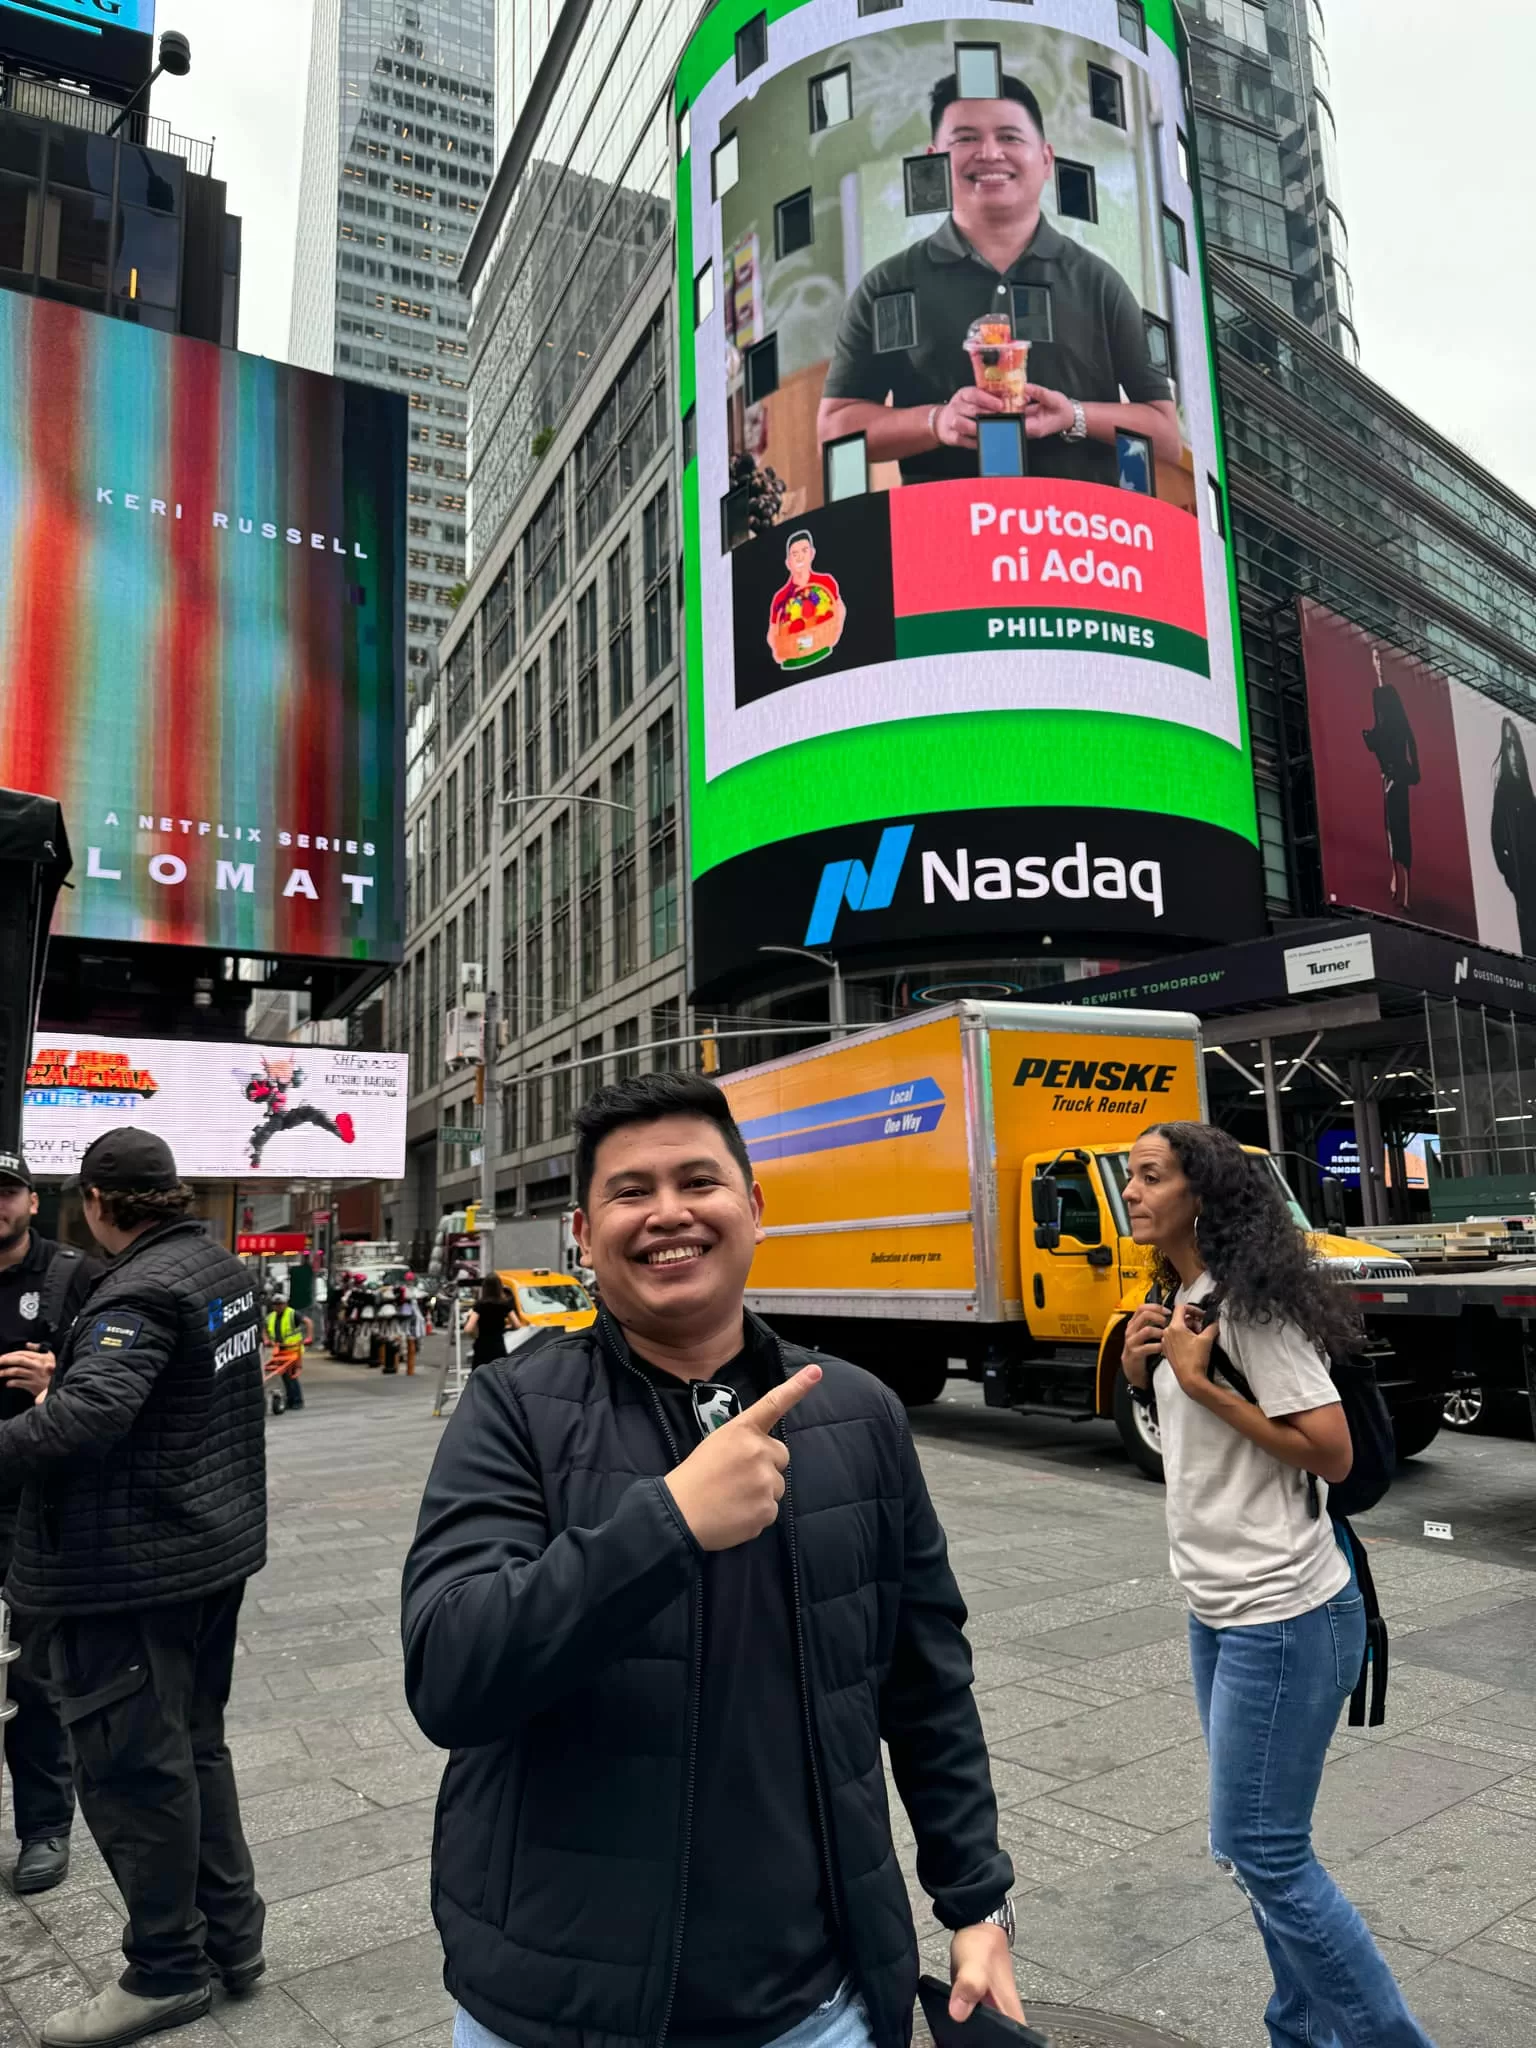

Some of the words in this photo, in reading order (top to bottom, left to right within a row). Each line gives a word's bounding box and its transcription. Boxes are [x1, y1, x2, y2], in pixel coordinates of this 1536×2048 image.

[96, 487, 183, 519] KERI
[212, 511, 368, 559] RUSSELL
[970, 502, 1154, 551] Prutasan
[992, 546, 1029, 582] ni
[1040, 549, 1143, 593] Adan
[988, 617, 1155, 649] PHILIPPINES
[104, 811, 120, 826] A
[138, 815, 262, 842] NETFLIX
[278, 831, 376, 857] SERIES
[86, 846, 375, 905] LOMAT
[922, 842, 1164, 917] Nasdaq
[1306, 960, 1351, 976] Turner
[1473, 968, 1504, 984] QUESTION
[1505, 977, 1524, 989] TODAY
[1082, 987, 1138, 1006] REWRITE
[1012, 1058, 1177, 1093] PENSKE
[889, 1084, 914, 1106] Local
[1052, 1095, 1094, 1112] Truck
[1097, 1096, 1148, 1114] Rental
[884, 1117, 901, 1134] One
[902, 1113, 922, 1132] Way
